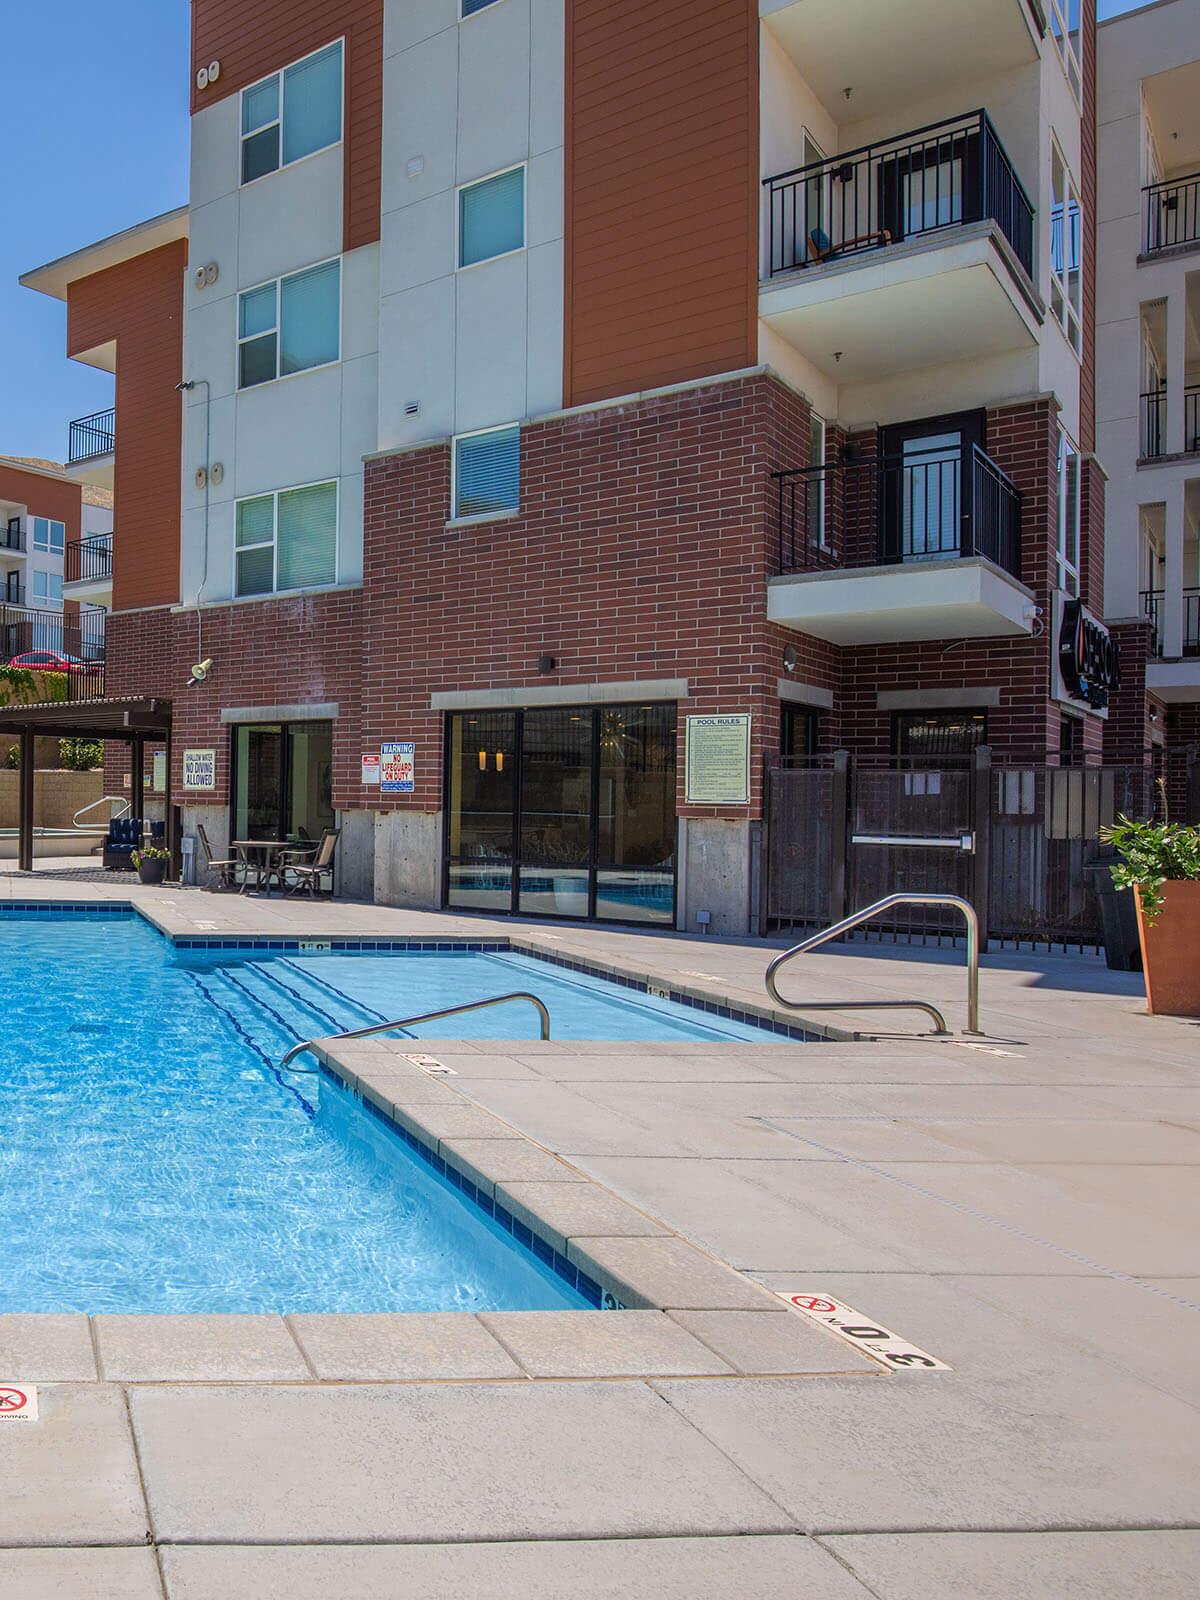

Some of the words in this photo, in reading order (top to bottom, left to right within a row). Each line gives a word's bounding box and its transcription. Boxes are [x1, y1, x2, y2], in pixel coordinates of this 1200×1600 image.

[383, 744, 413, 754] WARNING
[393, 754, 401, 763] NO
[186, 762, 193, 774] NO
[195, 762, 213, 774] DIVING
[382, 762, 412, 772] LIFEGUARD
[186, 774, 213, 786] ALLOWED
[385, 771, 393, 781] ON
[394, 771, 409, 781] DUTY
[839, 1325, 891, 1340] 0
[885, 1353, 937, 1367] 3
